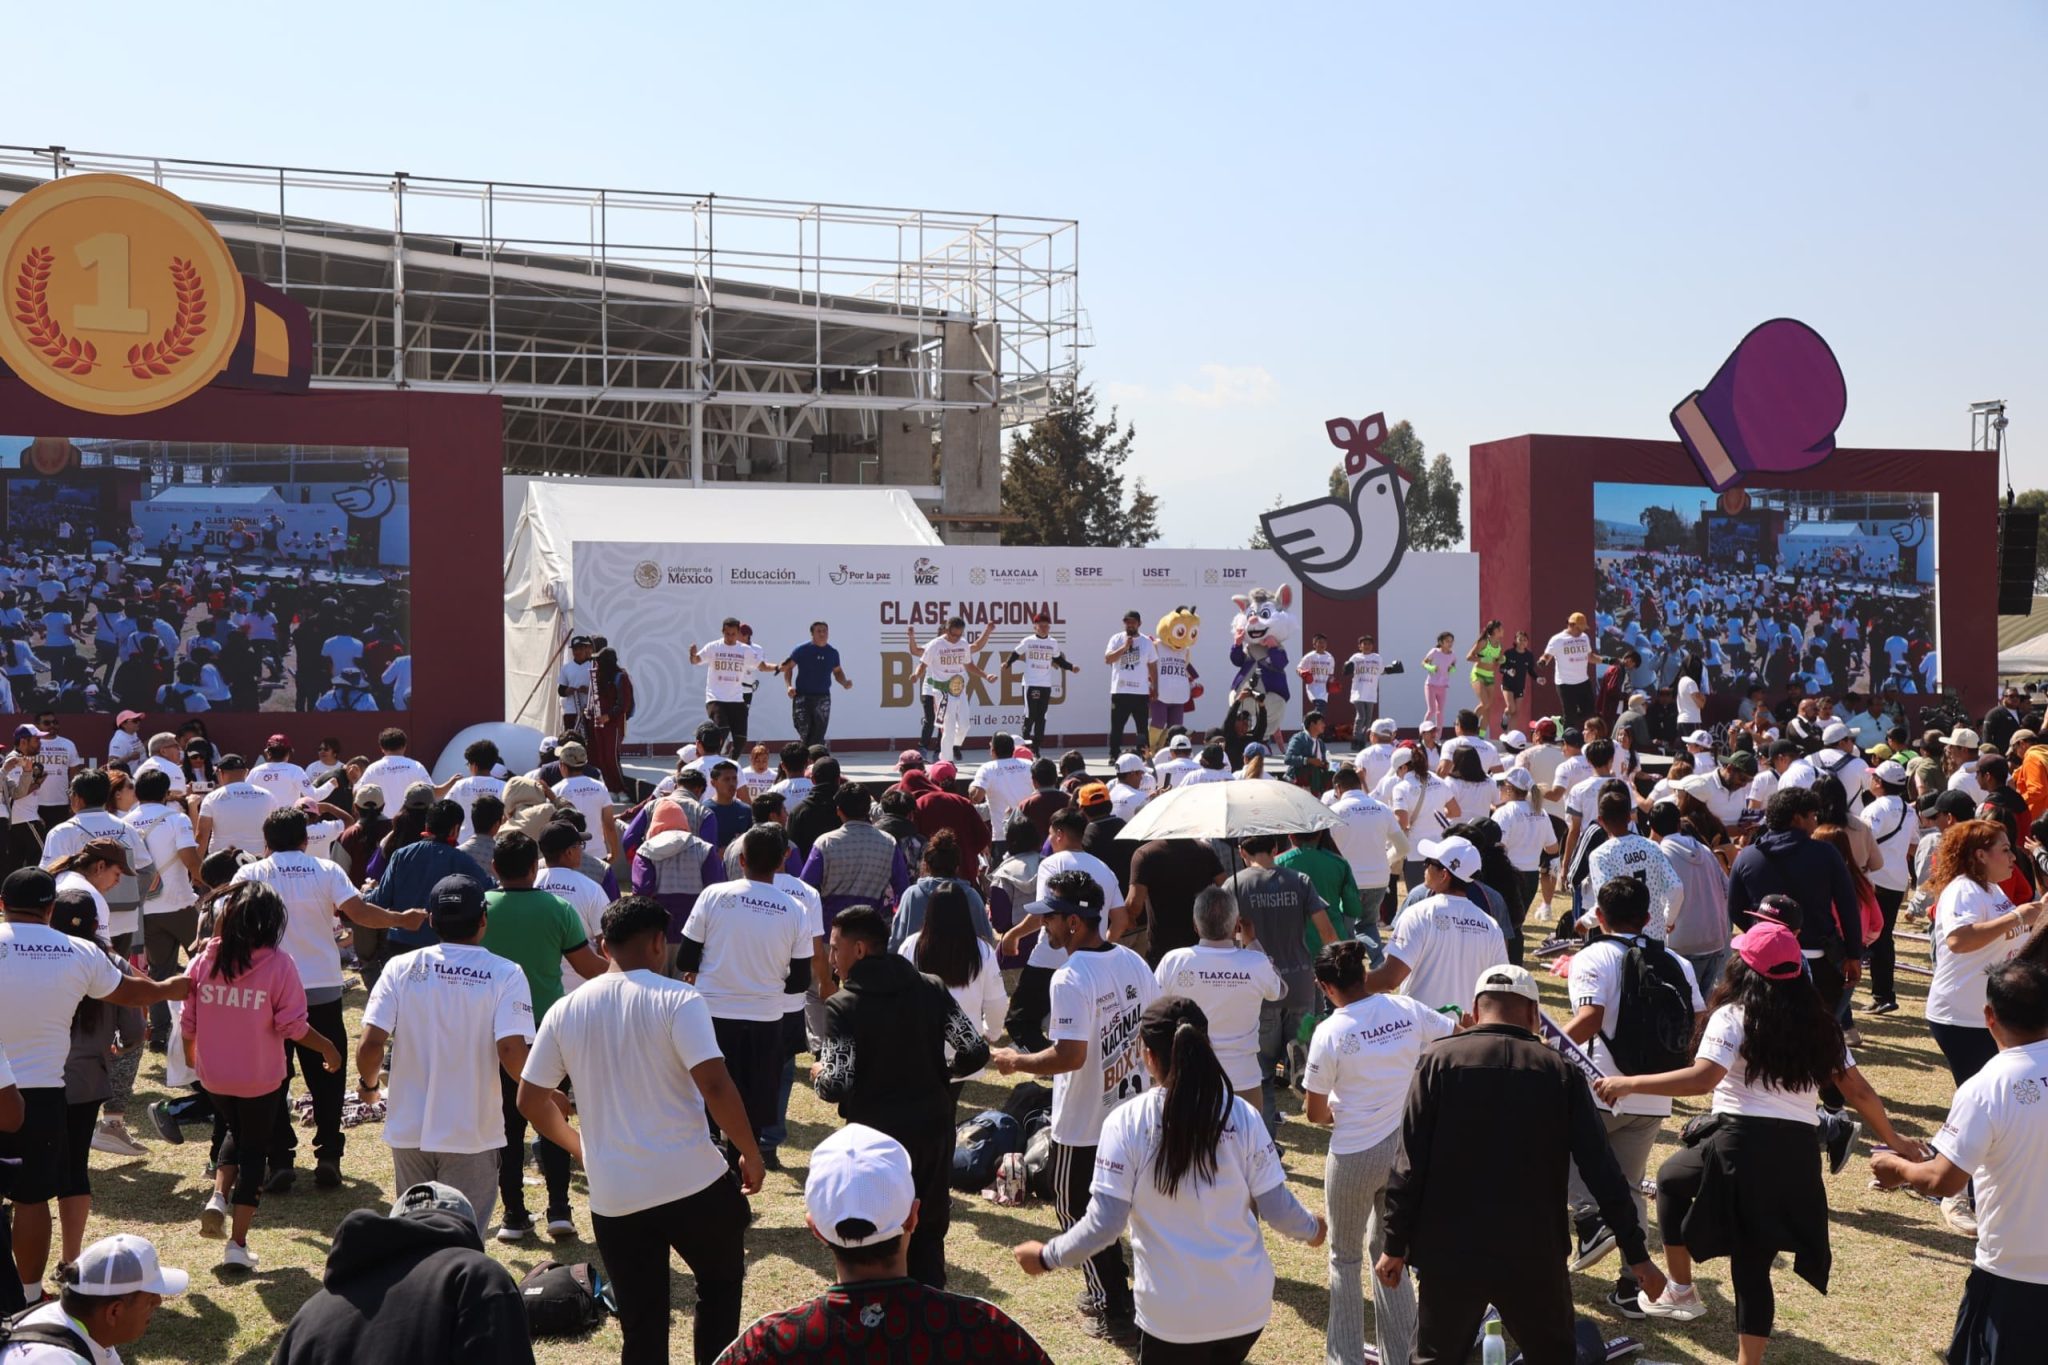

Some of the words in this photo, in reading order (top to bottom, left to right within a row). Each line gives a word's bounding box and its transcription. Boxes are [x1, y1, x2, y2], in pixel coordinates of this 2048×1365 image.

[73, 232, 150, 334] 1
[668, 572, 713, 584] México
[731, 568, 796, 580] Educación
[849, 571, 864, 580] Por
[866, 571, 875, 580] la
[876, 572, 891, 581] paz
[990, 569, 1038, 577] TLAXCALA
[1074, 567, 1103, 577] SEPE
[1142, 568, 1170, 577] USET
[1222, 568, 1247, 578] IDET
[914, 574, 939, 585] WBC
[880, 601, 951, 625] CLASE
[984, 714, 998, 725] de
[740, 896, 788, 913] TLAXCALA
[1249, 891, 1299, 909] FINISHER
[1451, 916, 1490, 931] TLAXCALA
[12, 943, 75, 954] TLAXCALA
[433, 963, 492, 980] TLAXCALA
[1198, 971, 1251, 980] TLAXCALA
[201, 983, 268, 1011] STAFF
[1360, 1019, 1413, 1040] TLAXCALA
